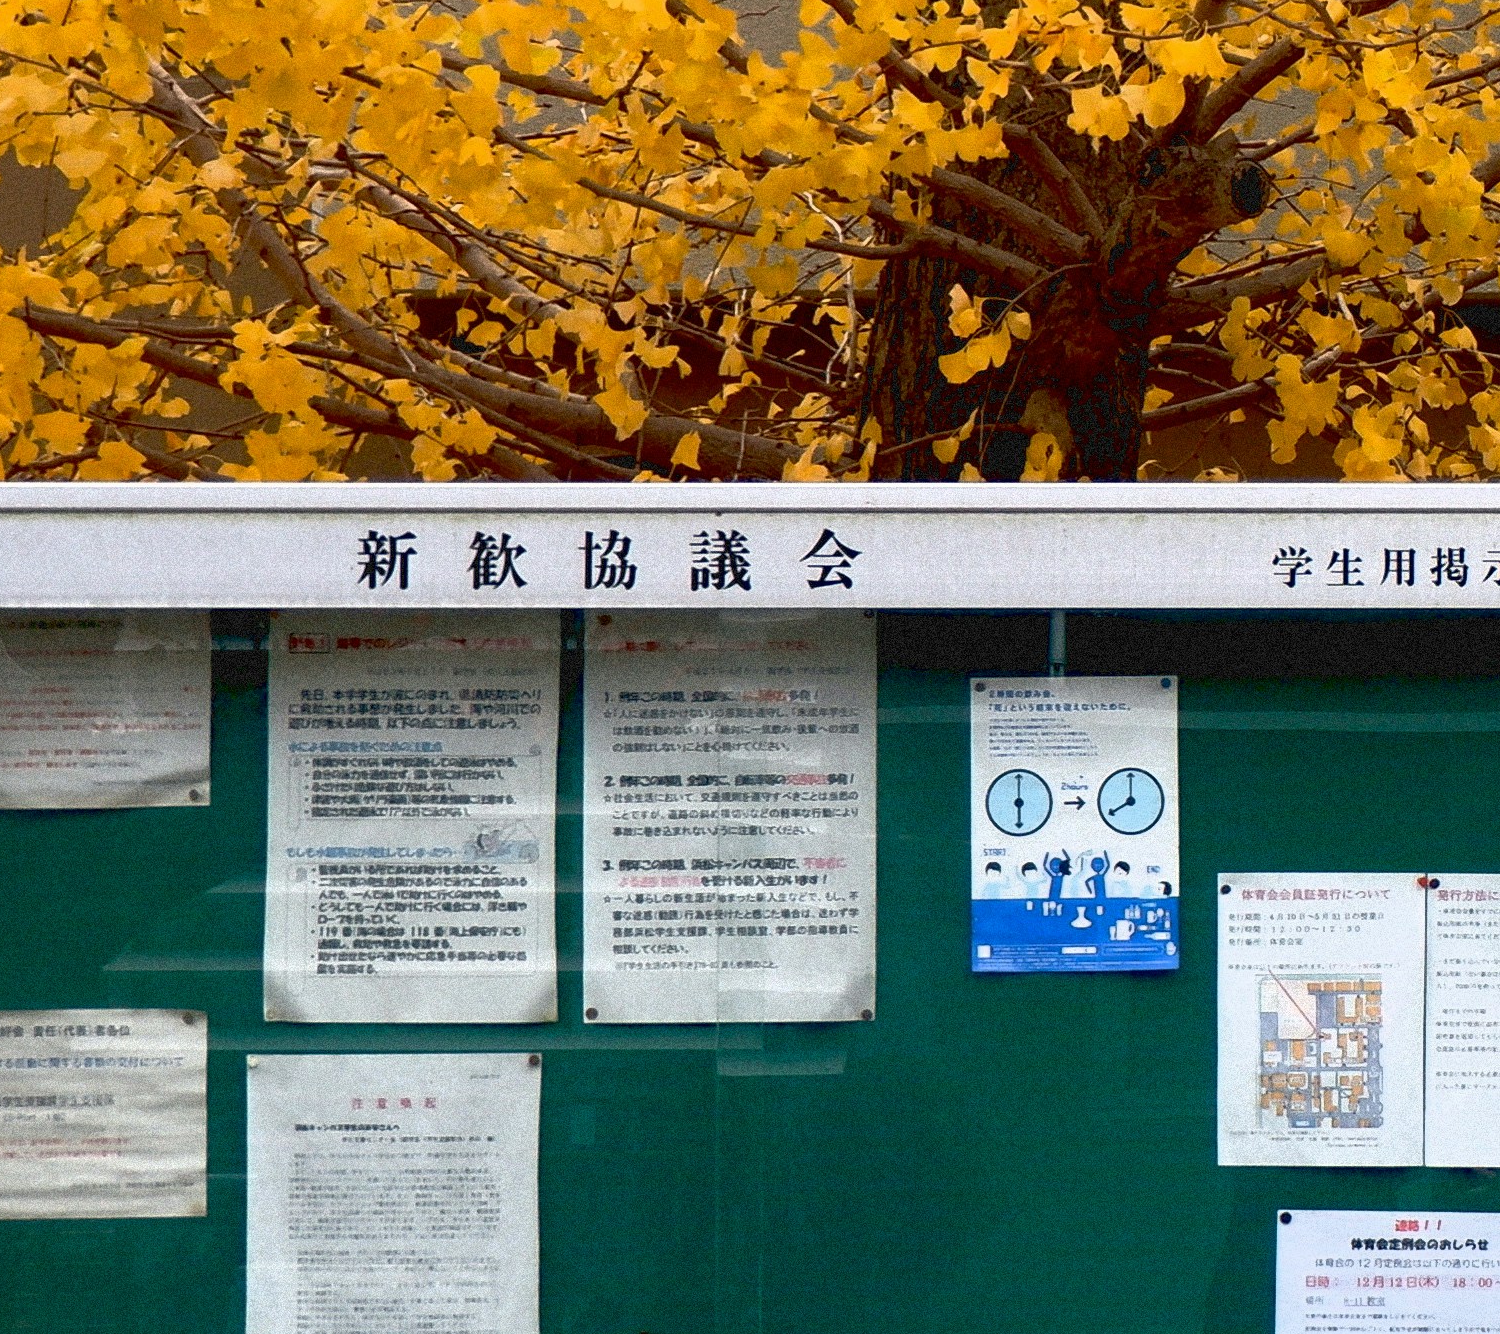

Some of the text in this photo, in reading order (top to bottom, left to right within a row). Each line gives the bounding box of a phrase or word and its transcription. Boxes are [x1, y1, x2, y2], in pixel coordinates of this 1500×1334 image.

[357, 529, 864, 593] 新歓協議会
